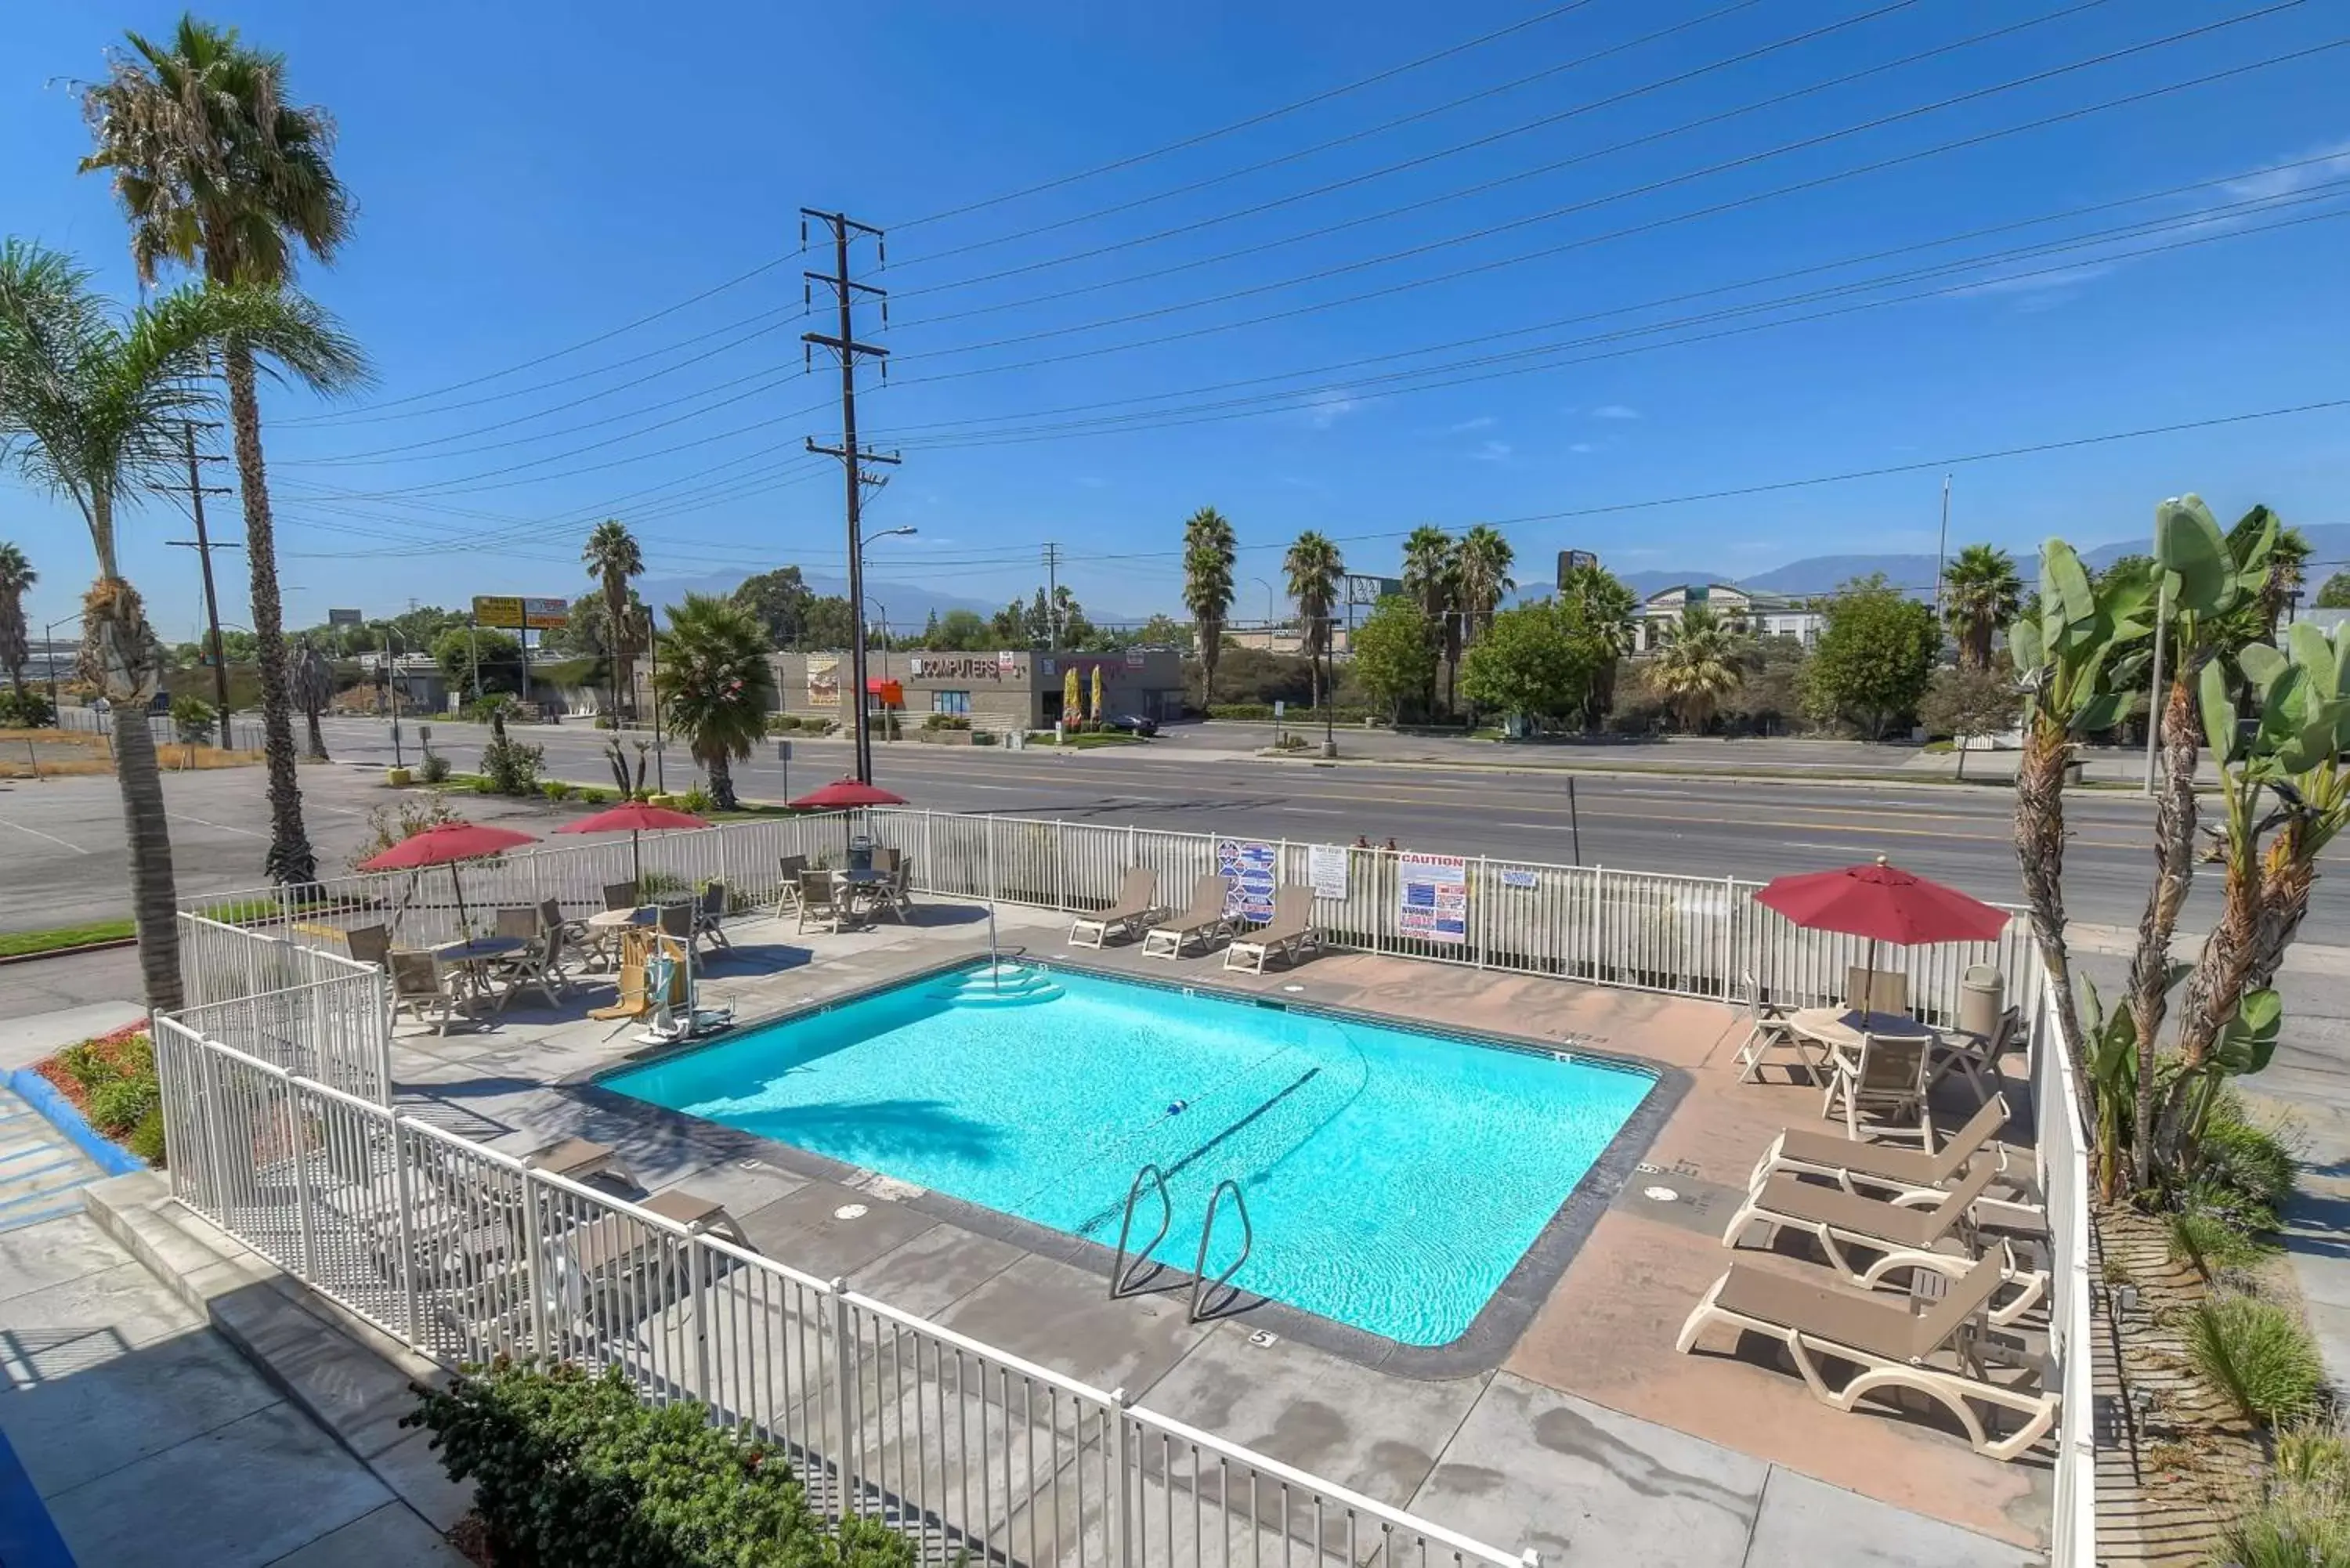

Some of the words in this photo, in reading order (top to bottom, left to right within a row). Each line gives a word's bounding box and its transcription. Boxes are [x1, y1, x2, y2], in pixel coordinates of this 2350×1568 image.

[922, 658, 997, 674] COMPUTERS
[1401, 854, 1463, 867] CAUTION
[1251, 1331, 1267, 1343] 5
